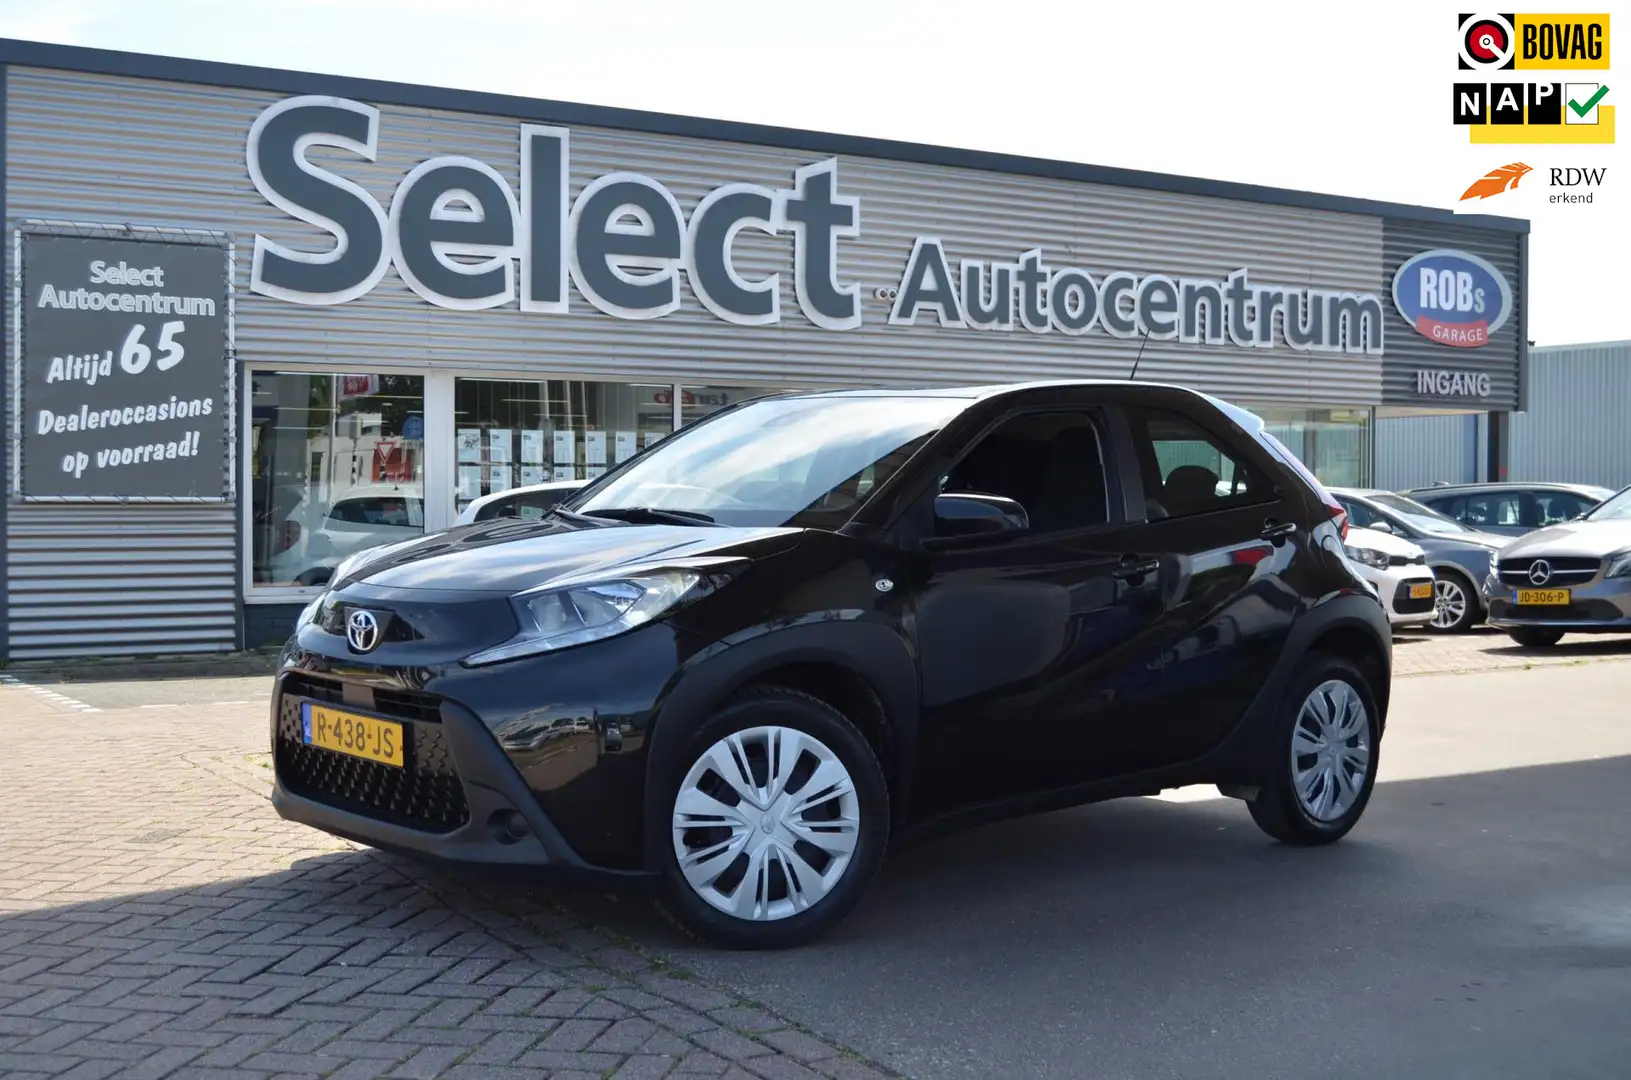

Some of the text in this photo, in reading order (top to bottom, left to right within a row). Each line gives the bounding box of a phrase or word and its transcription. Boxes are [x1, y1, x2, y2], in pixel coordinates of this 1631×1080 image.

[246, 95, 1385, 355] Select Autocentrum
[90, 260, 164, 287] Select
[37, 284, 216, 316] Autocentrum
[1432, 324, 1484, 341] GARAGE
[46, 321, 185, 385] Altijd 65
[1416, 369, 1491, 397] INGANG
[37, 396, 213, 435] Dealeroccasions
[62, 431, 200, 479] op voorraad!
[317, 711, 394, 758] R-438-JS
